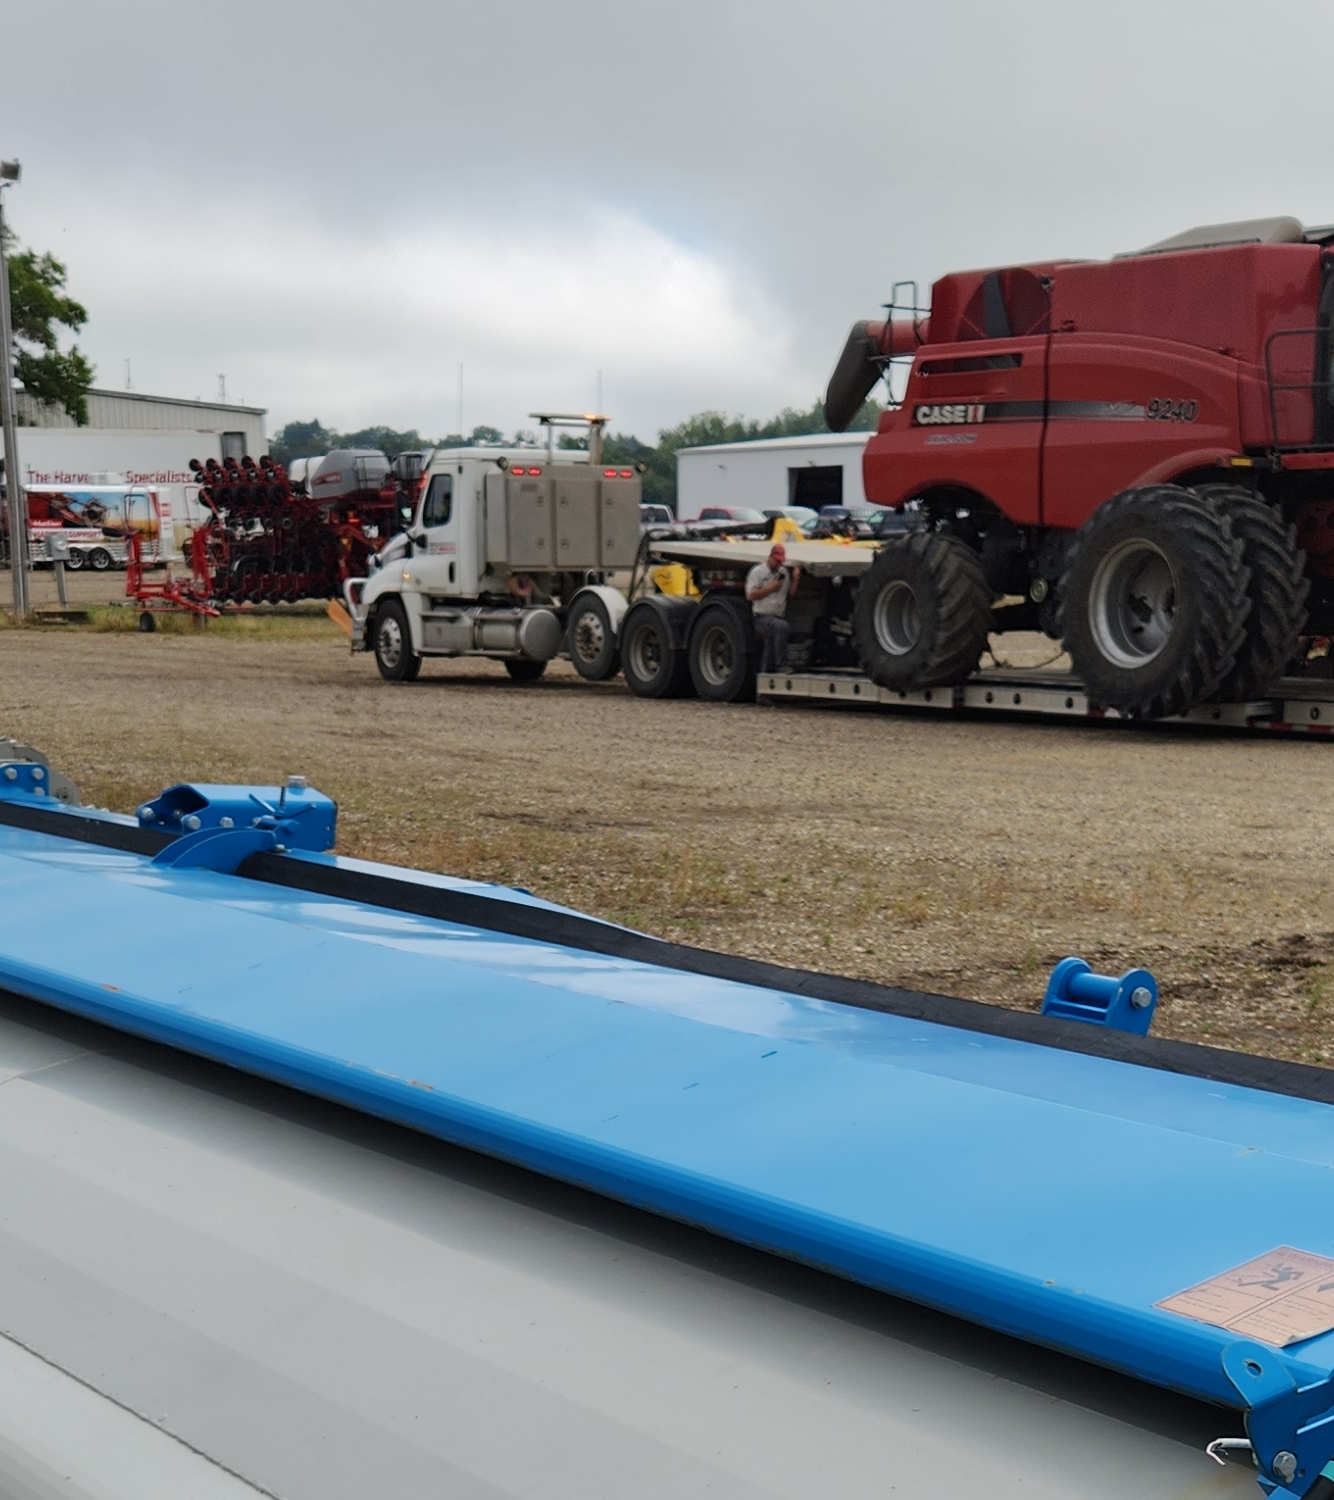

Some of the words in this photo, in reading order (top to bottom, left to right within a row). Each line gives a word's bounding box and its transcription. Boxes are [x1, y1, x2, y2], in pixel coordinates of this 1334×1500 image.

[917, 404, 965, 425] CASE
[1146, 399, 1198, 422] 9240
[27, 470, 49, 484] The
